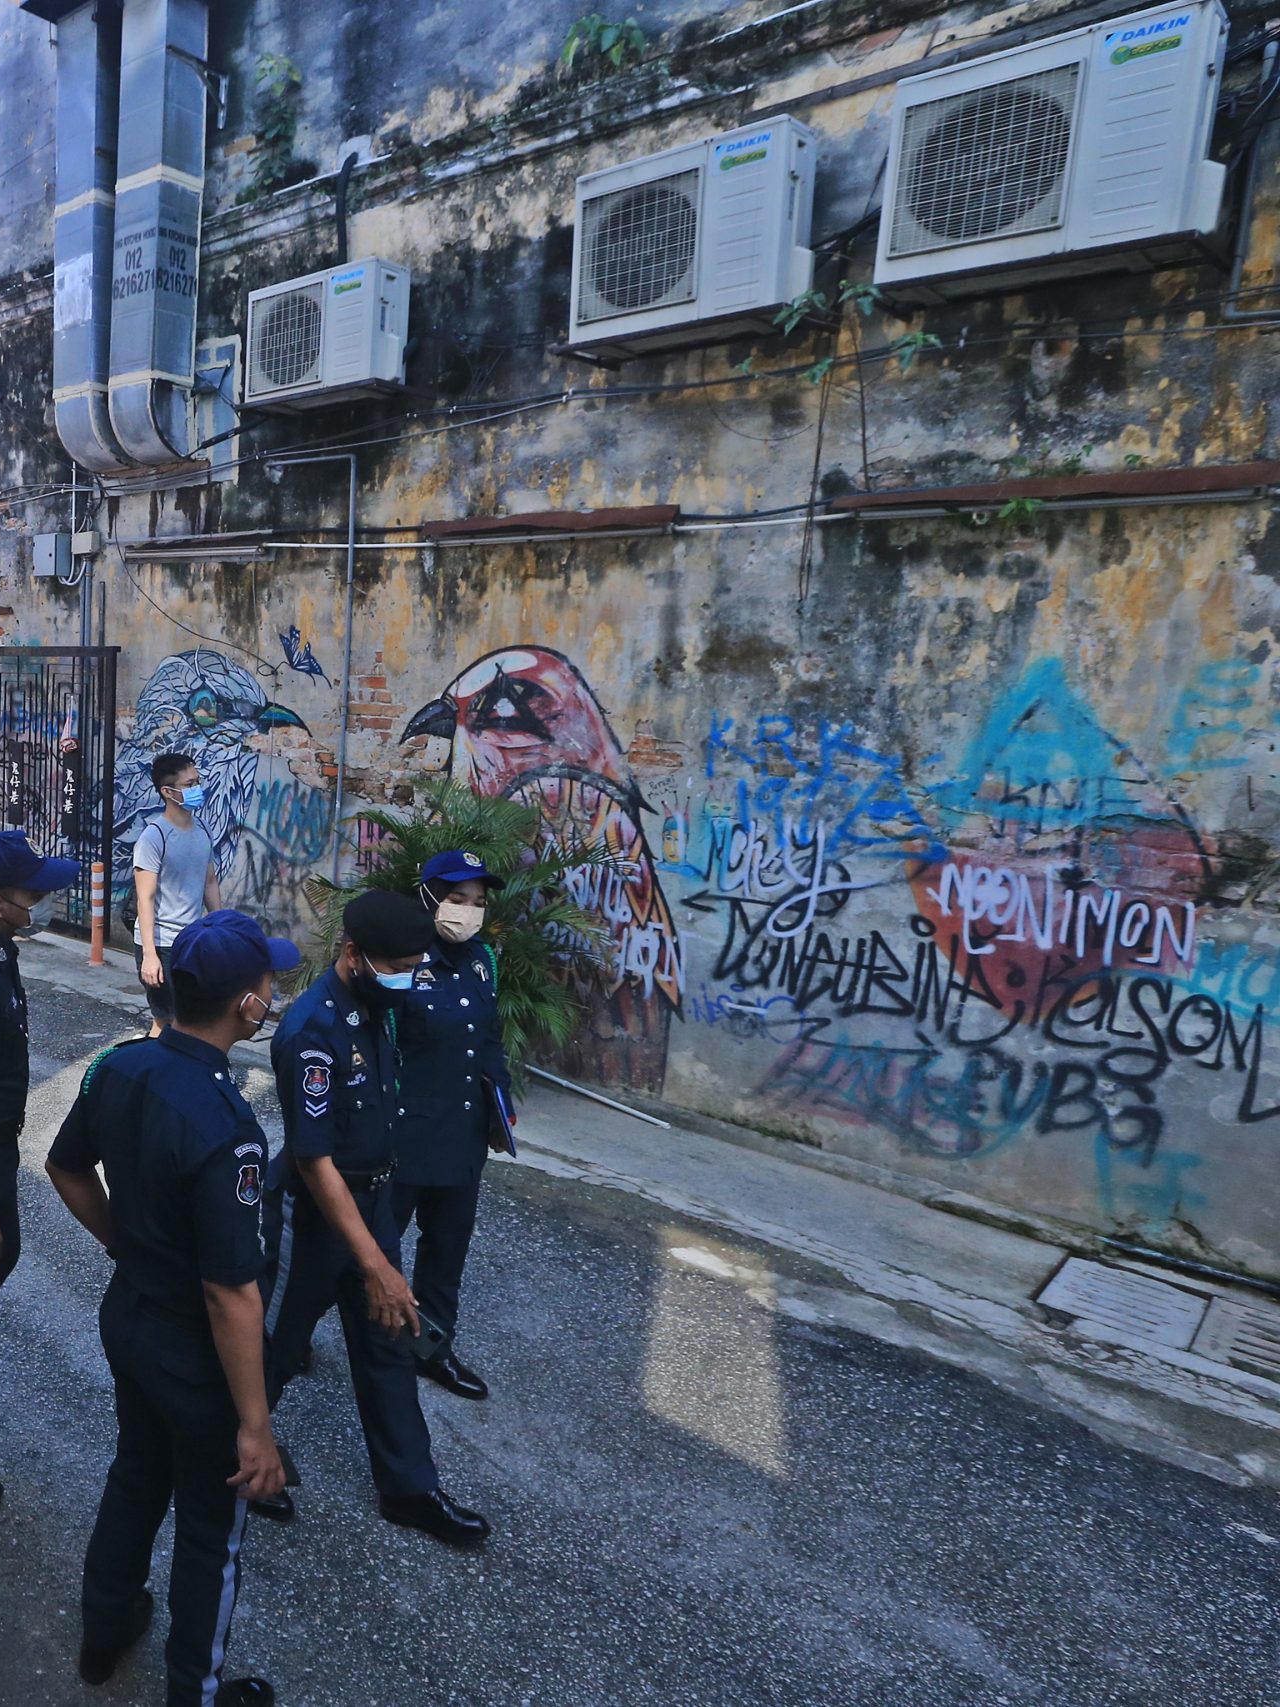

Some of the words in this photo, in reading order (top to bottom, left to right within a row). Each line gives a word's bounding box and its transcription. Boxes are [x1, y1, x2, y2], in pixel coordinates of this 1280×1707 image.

[1121, 16, 1190, 41] DAIKIN
[726, 133, 771, 152] DAIKIN
[125, 246, 142, 270] 012
[169, 245, 186, 270] 012
[112, 268, 155, 299] 6216271
[10, 761, 21, 805] 鬼仔巷
[63, 768, 76, 814] 鬼仔巷
